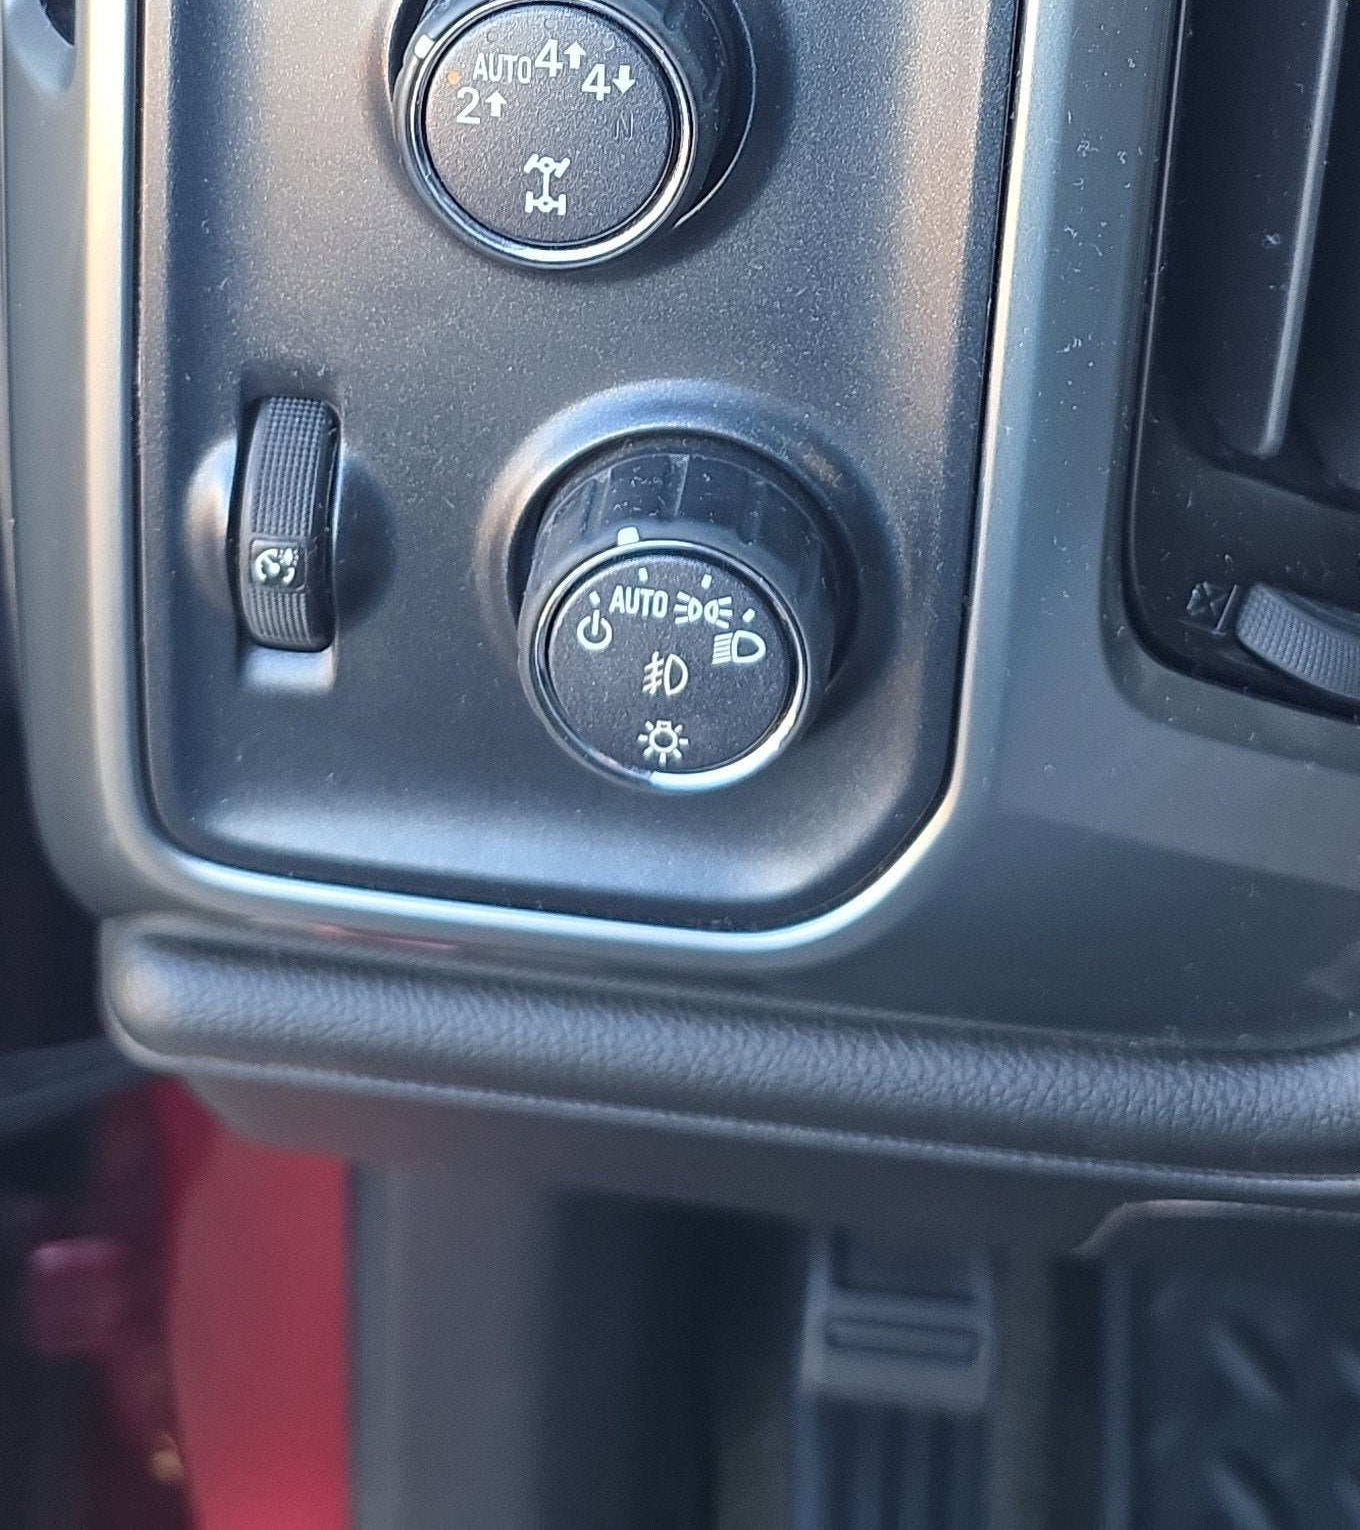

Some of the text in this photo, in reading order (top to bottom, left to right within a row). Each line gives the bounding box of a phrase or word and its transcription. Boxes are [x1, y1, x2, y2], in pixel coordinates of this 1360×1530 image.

[473, 52, 532, 85] AUTO
[535, 38, 564, 77] 4
[581, 63, 611, 101] 4
[456, 86, 481, 125] 2
[609, 585, 669, 619] AUTO
